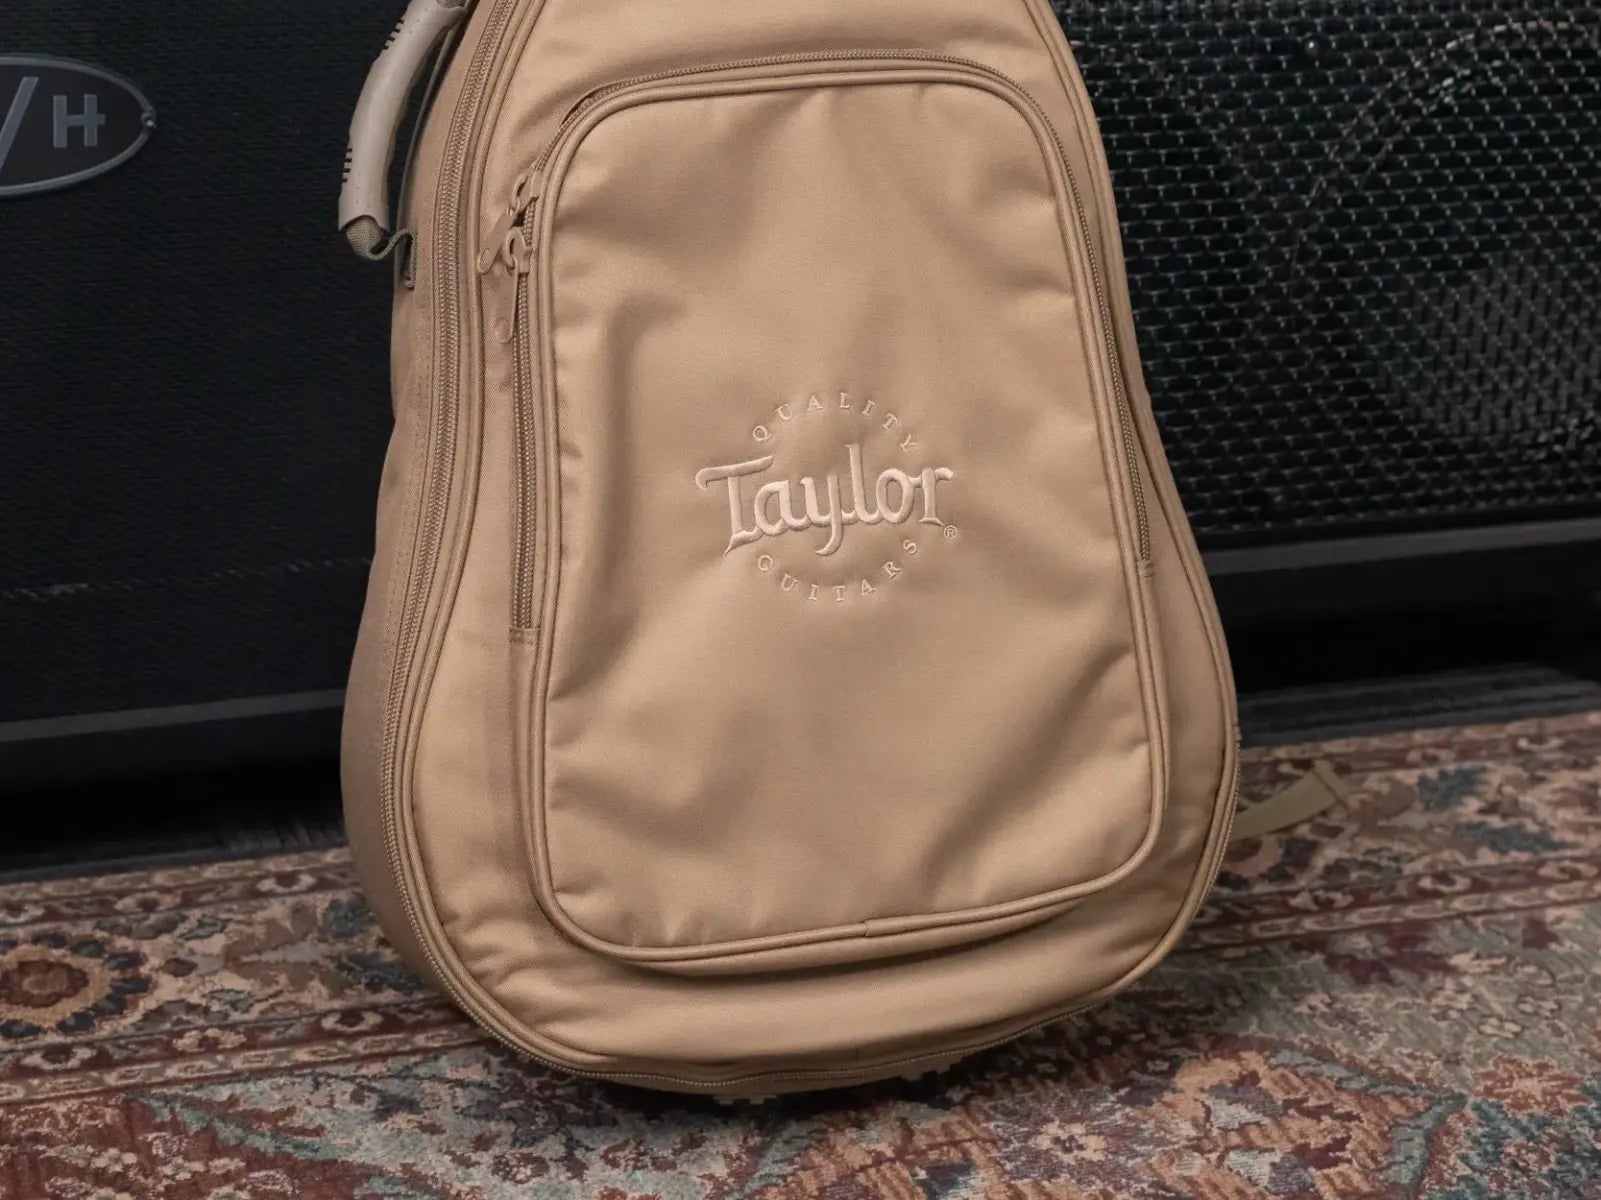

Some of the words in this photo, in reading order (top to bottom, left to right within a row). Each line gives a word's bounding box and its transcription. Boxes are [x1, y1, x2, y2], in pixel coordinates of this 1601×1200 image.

[752, 391, 918, 452] QUALITY
[695, 443, 954, 557] Taylor
[757, 538, 919, 602] GUITARS
